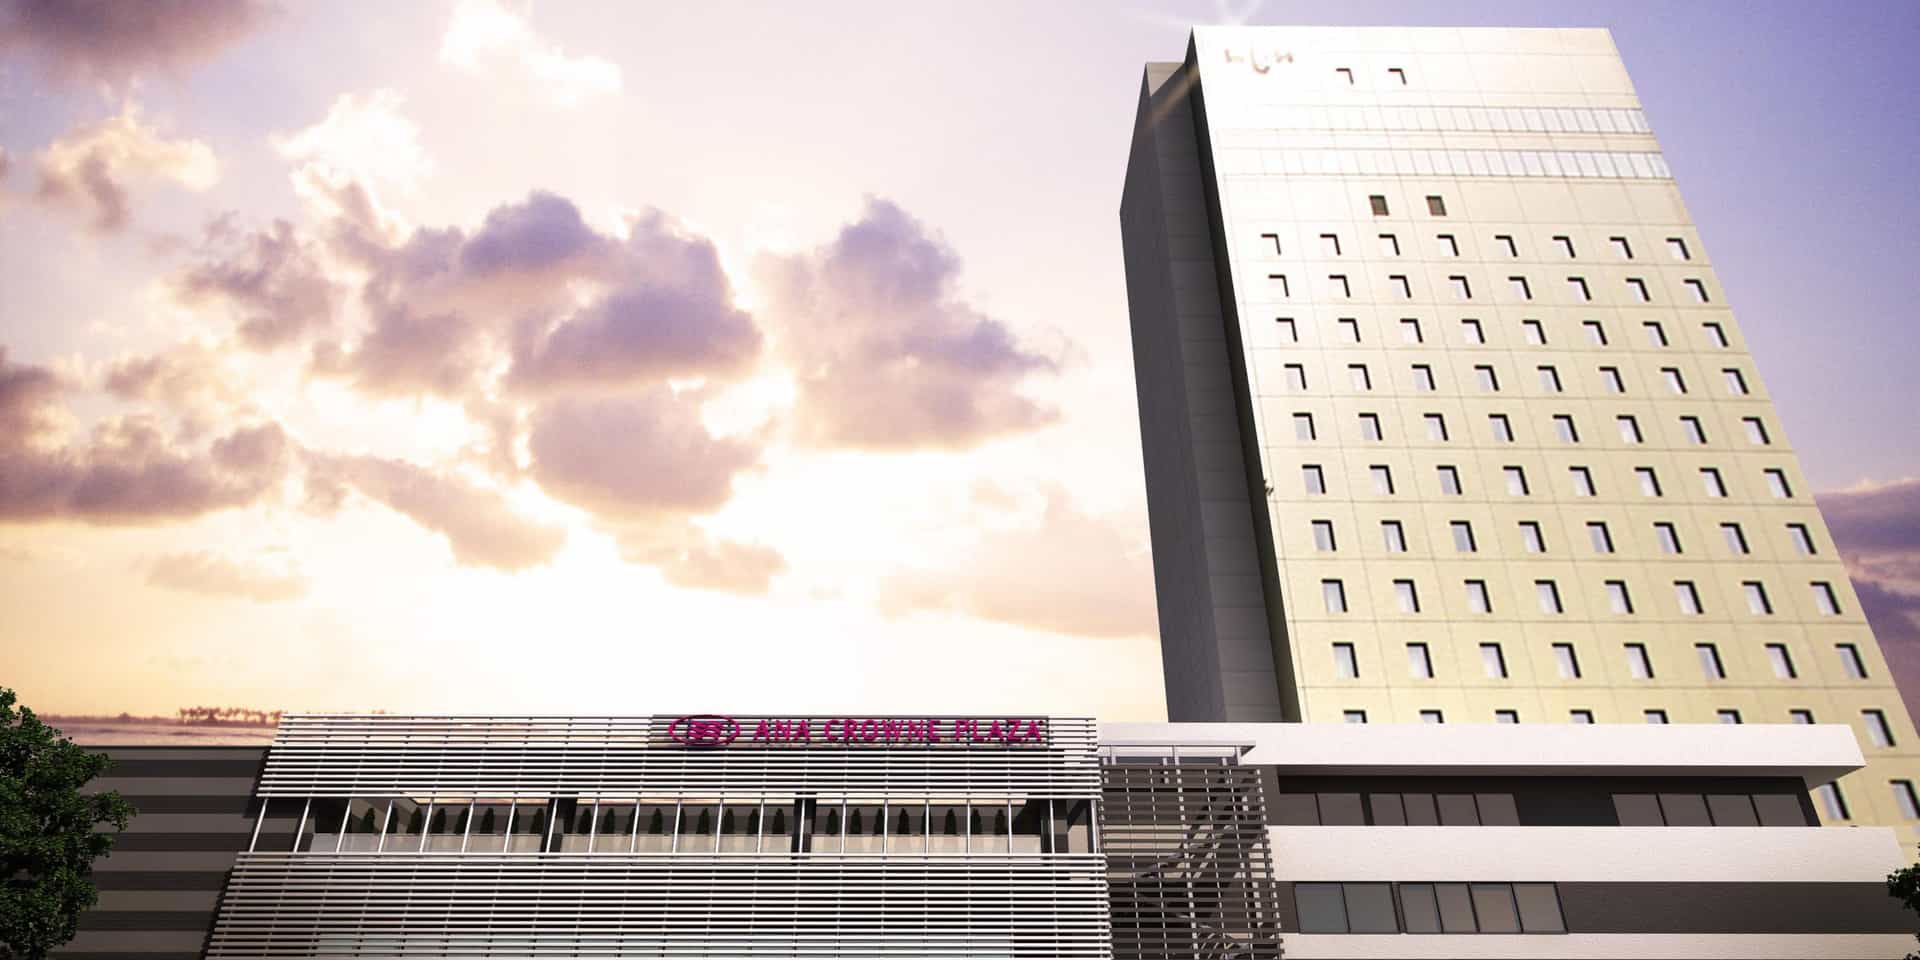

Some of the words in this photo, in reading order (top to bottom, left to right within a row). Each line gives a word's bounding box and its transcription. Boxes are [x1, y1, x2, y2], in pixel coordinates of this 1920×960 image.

[753, 720, 810, 742] ANA
[823, 719, 941, 742] CROWNE
[955, 719, 1042, 742] PLAZA
